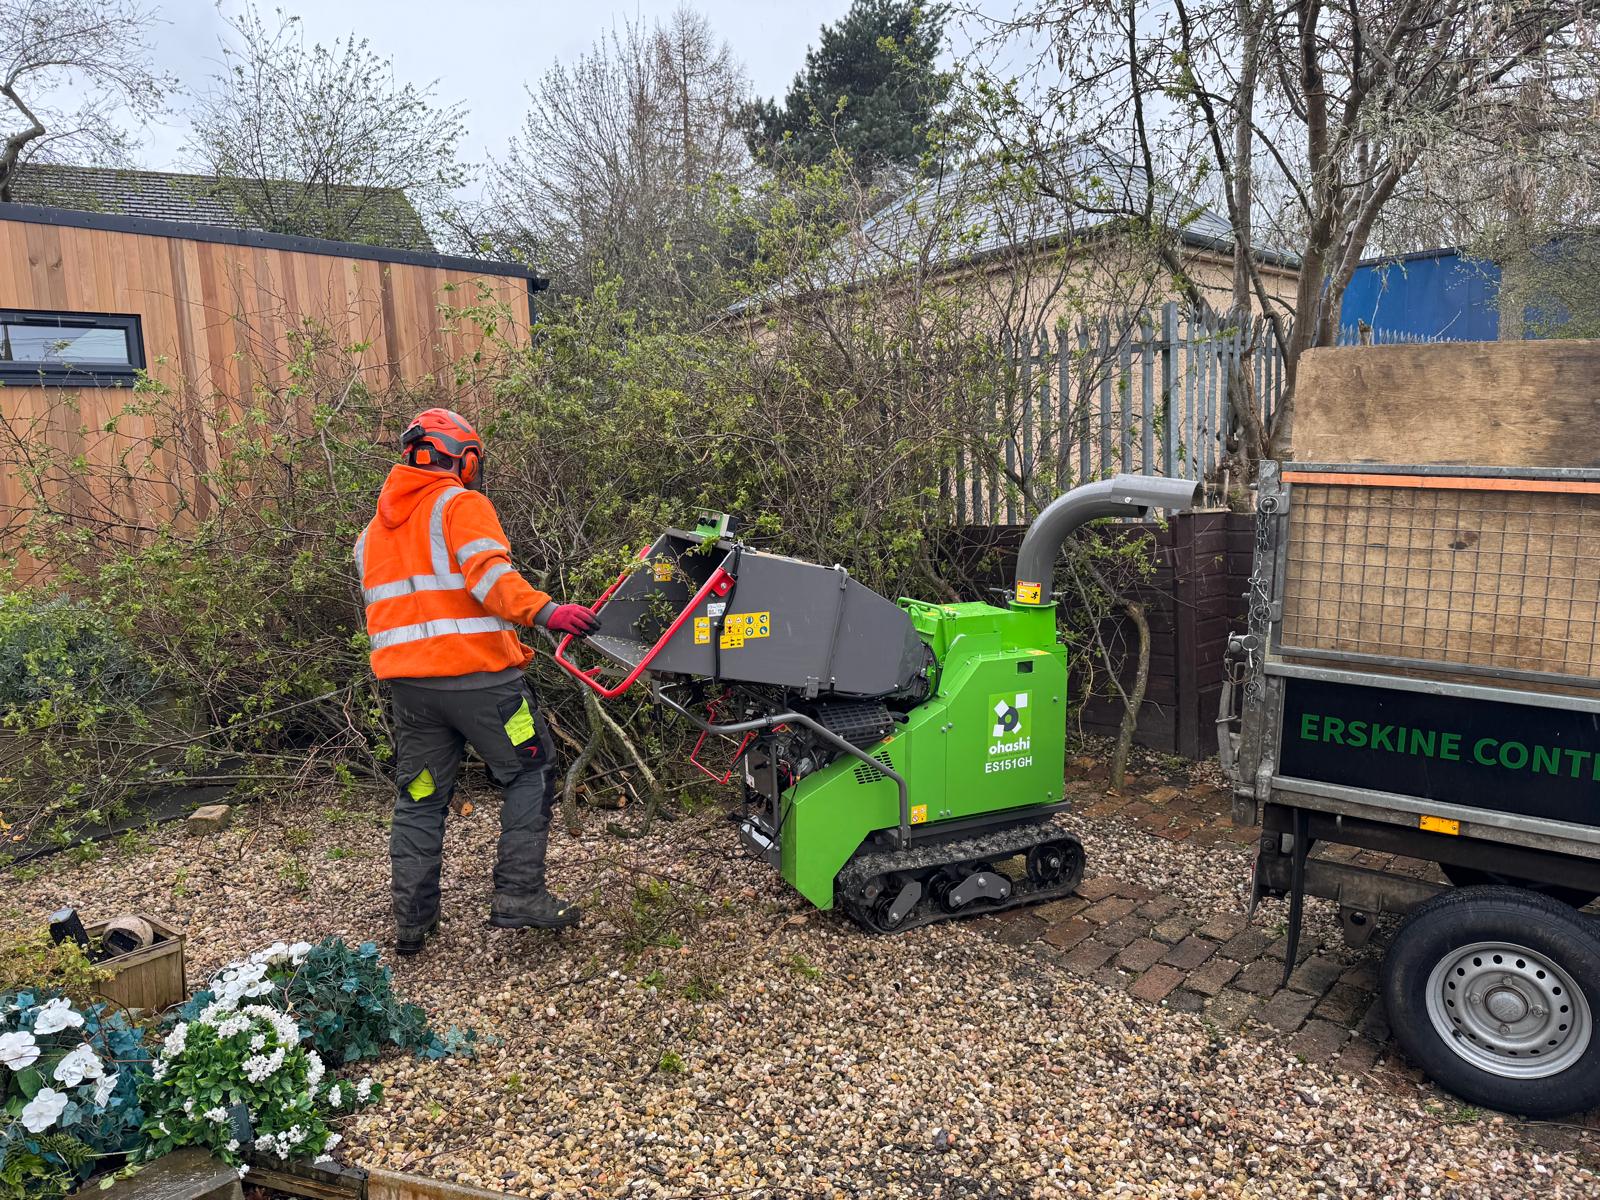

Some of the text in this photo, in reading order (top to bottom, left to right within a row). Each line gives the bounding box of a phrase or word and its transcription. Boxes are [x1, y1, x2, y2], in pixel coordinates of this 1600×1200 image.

[989, 737, 1031, 754] ohashi
[1300, 713, 1462, 761] ERSKINE
[985, 756, 1033, 773] ES151GH
